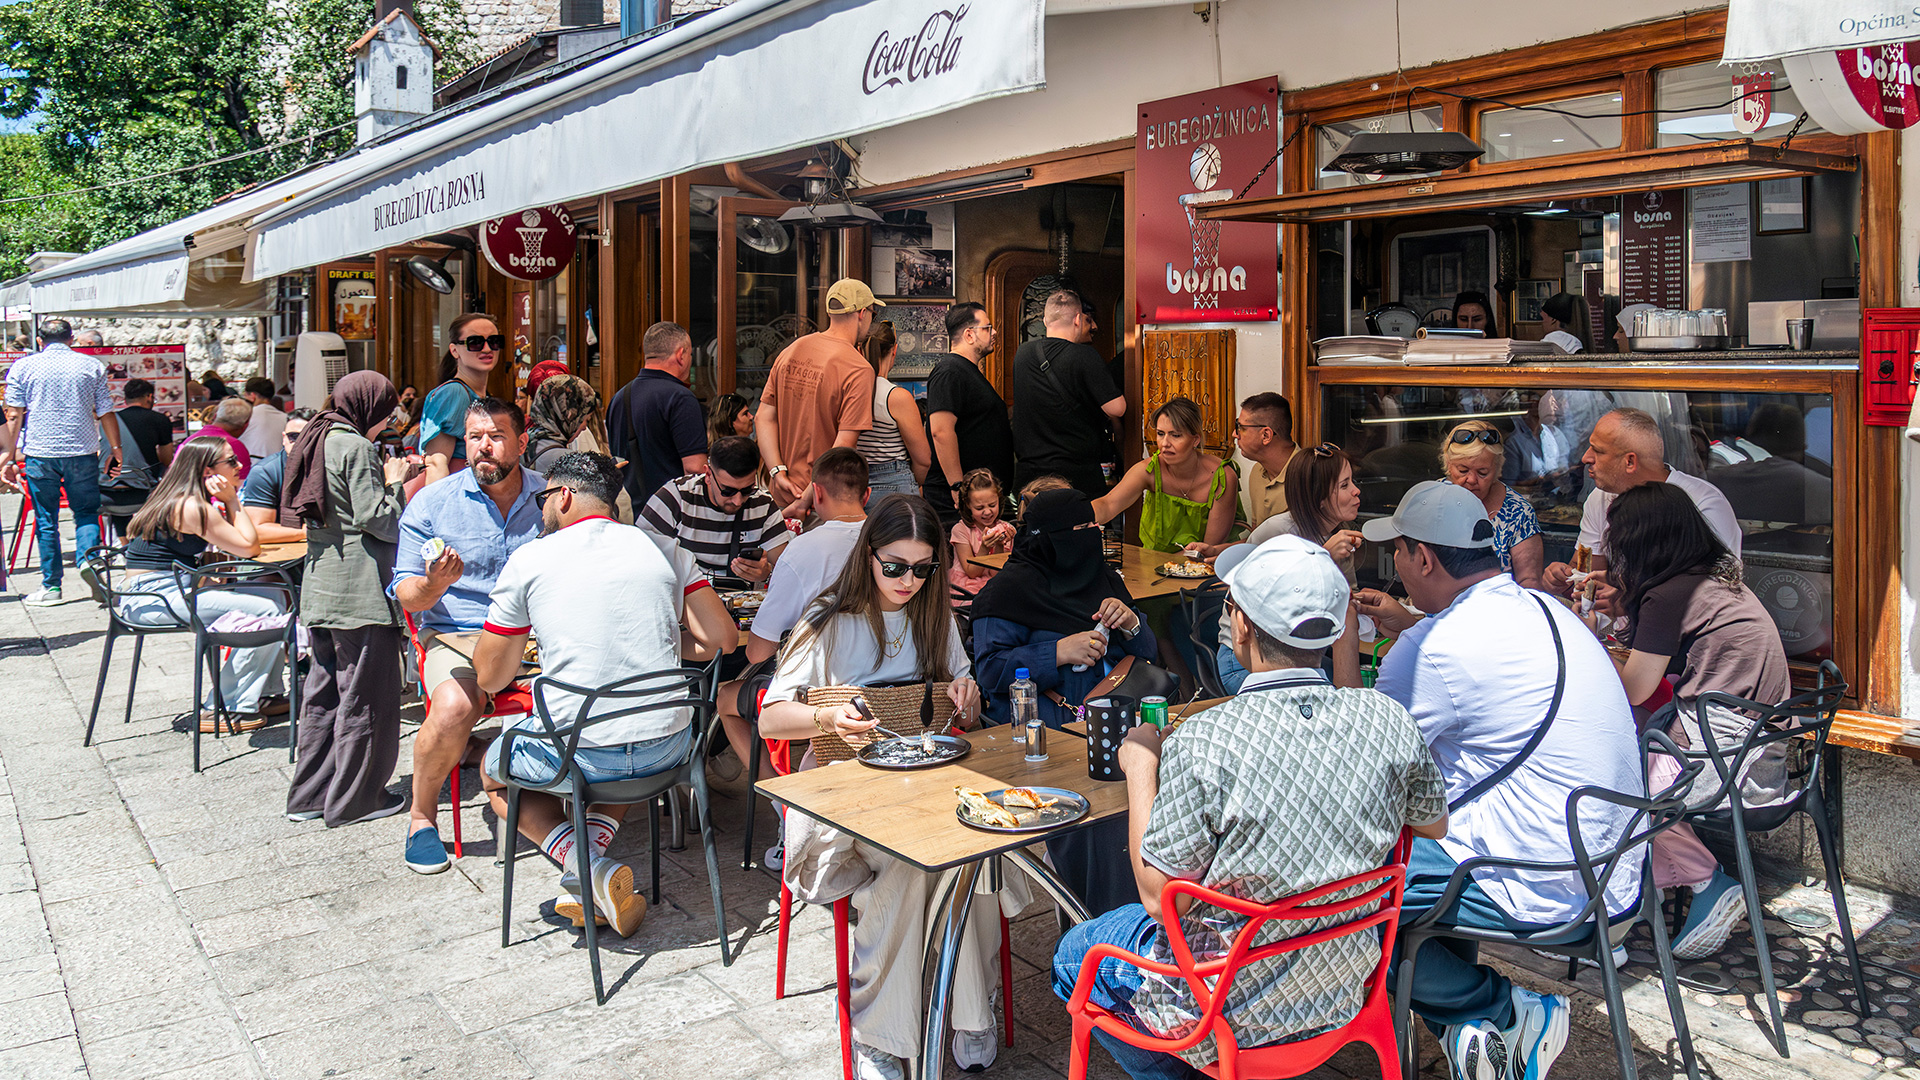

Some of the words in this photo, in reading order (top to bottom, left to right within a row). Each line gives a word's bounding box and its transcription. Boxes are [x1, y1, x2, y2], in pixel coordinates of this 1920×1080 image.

[1839, 14, 1905, 37] Općina
[1732, 72, 1771, 86] bosna
[1146, 103, 1271, 150] BUREGDŽINICA
[447, 170, 485, 210] BOSNA
[1634, 211, 1672, 224] bosna
[509, 253, 557, 267] bosna
[328, 270, 361, 279] DRAFT
[1166, 262, 1247, 295] bosna
